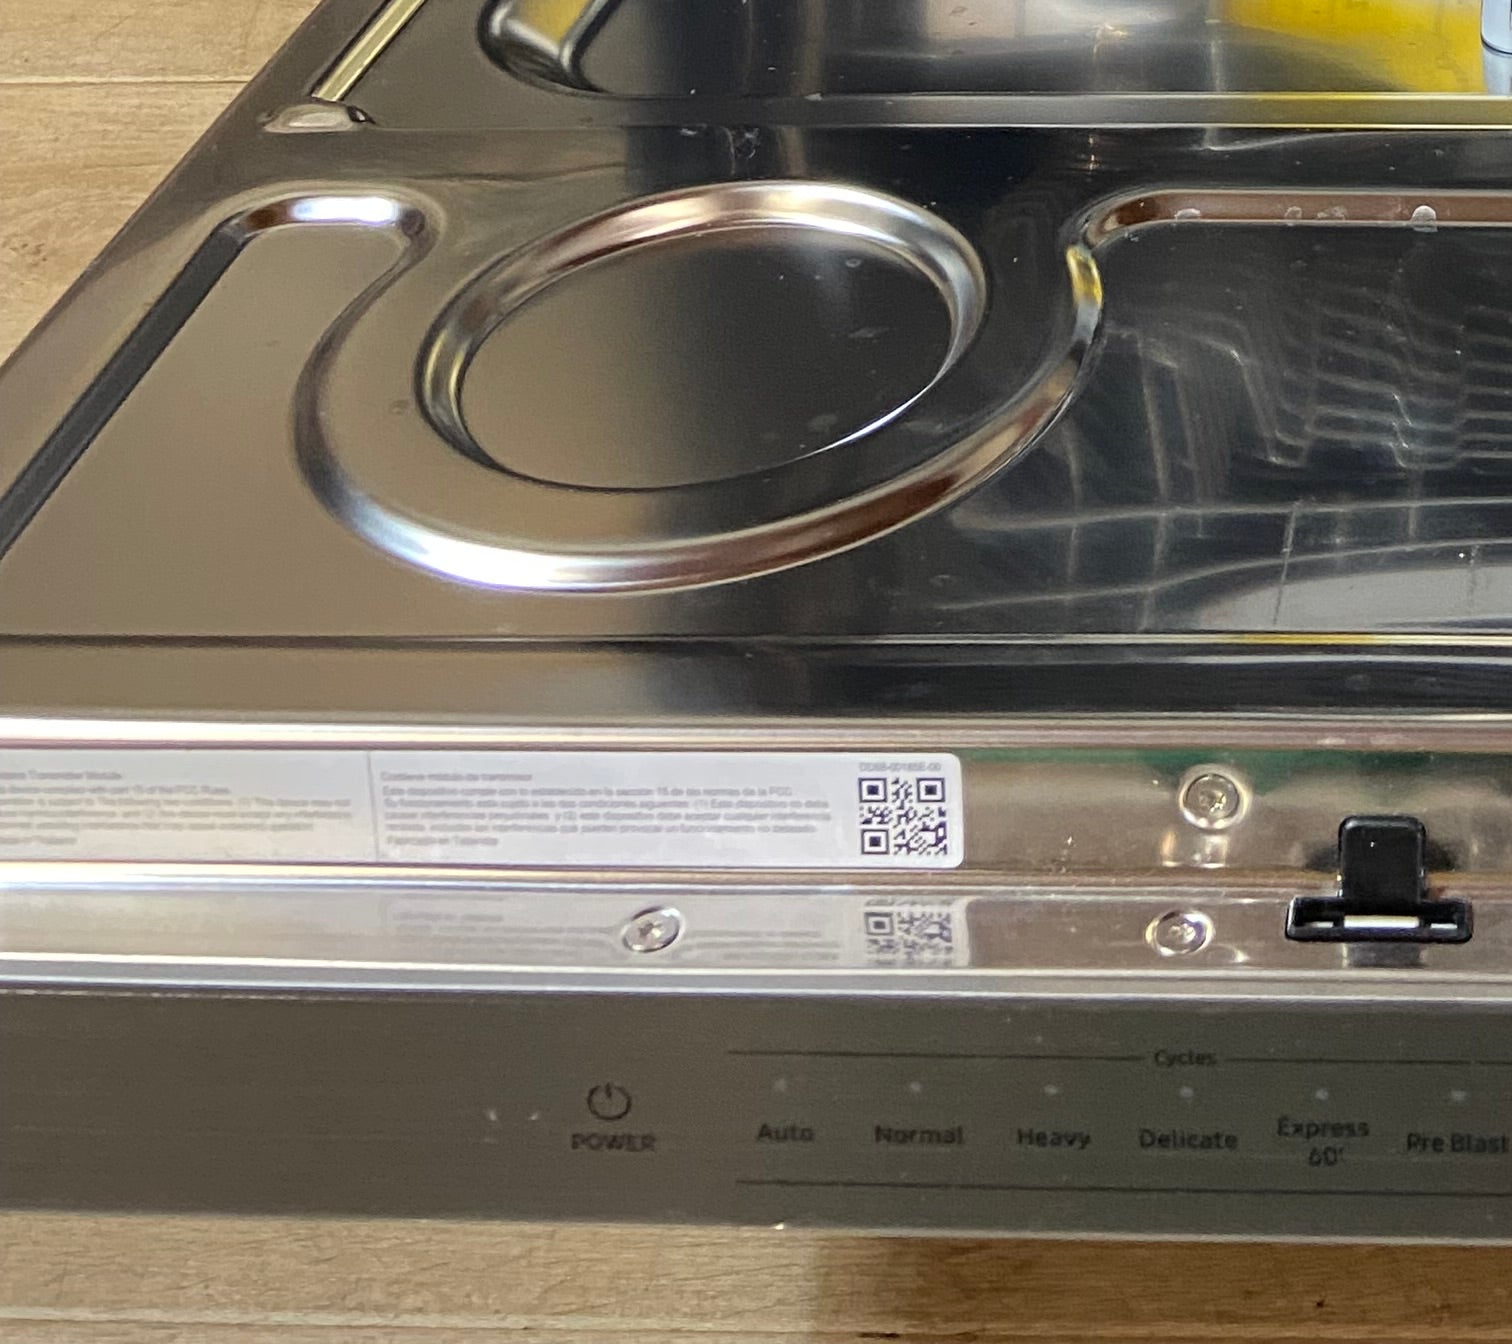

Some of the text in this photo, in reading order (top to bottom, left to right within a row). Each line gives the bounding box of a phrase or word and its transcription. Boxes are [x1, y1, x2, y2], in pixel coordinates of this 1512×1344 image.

[1154, 1048, 1218, 1068] Cycles
[756, 1122, 816, 1143] Auto
[874, 1124, 965, 1146] Normal
[1017, 1128, 1092, 1150] Heavy
[1138, 1128, 1239, 1150] Delicate
[1276, 1117, 1370, 1140] Express
[570, 1132, 657, 1153] POWER
[1406, 1133, 1510, 1156] Pre Blast
